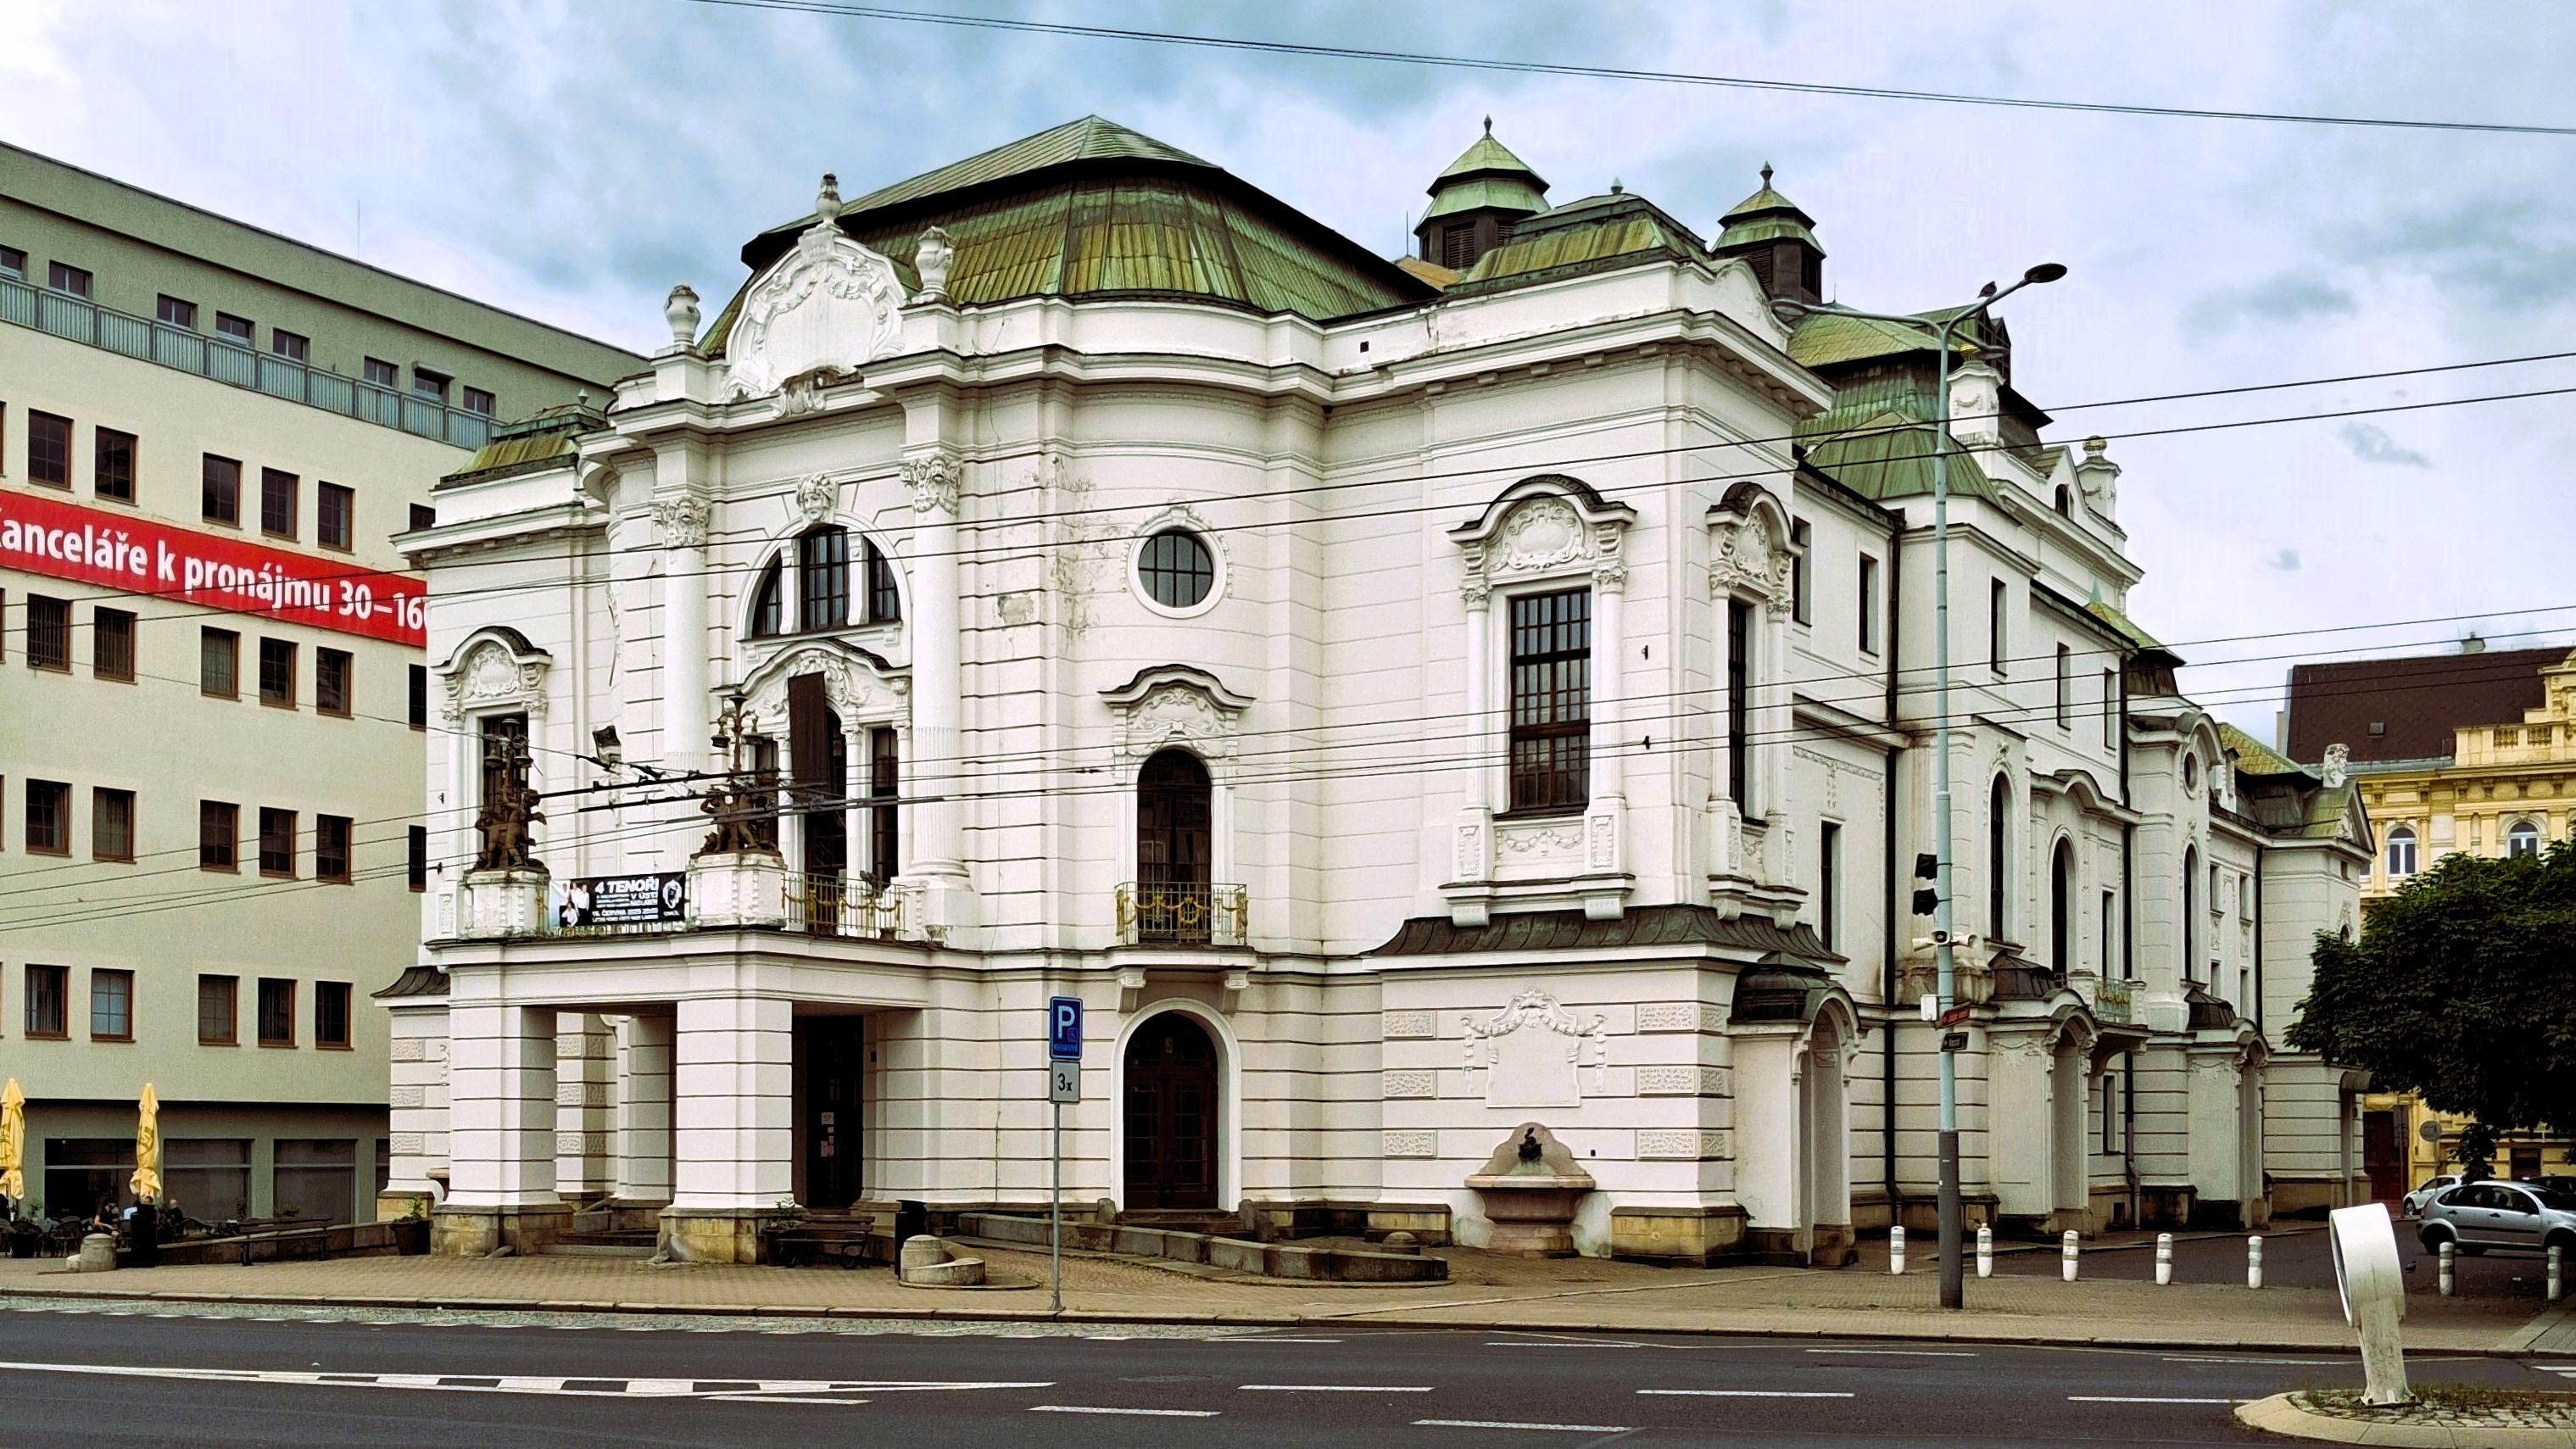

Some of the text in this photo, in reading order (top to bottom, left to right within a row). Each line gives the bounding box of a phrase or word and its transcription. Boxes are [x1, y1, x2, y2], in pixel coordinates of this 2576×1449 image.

[0, 507, 427, 631] anceláře k pronájmu 30–16
[594, 876, 660, 894] 4 TENOŘI
[1057, 1005, 1076, 1039] P
[1057, 1073, 1073, 1092] 3x
